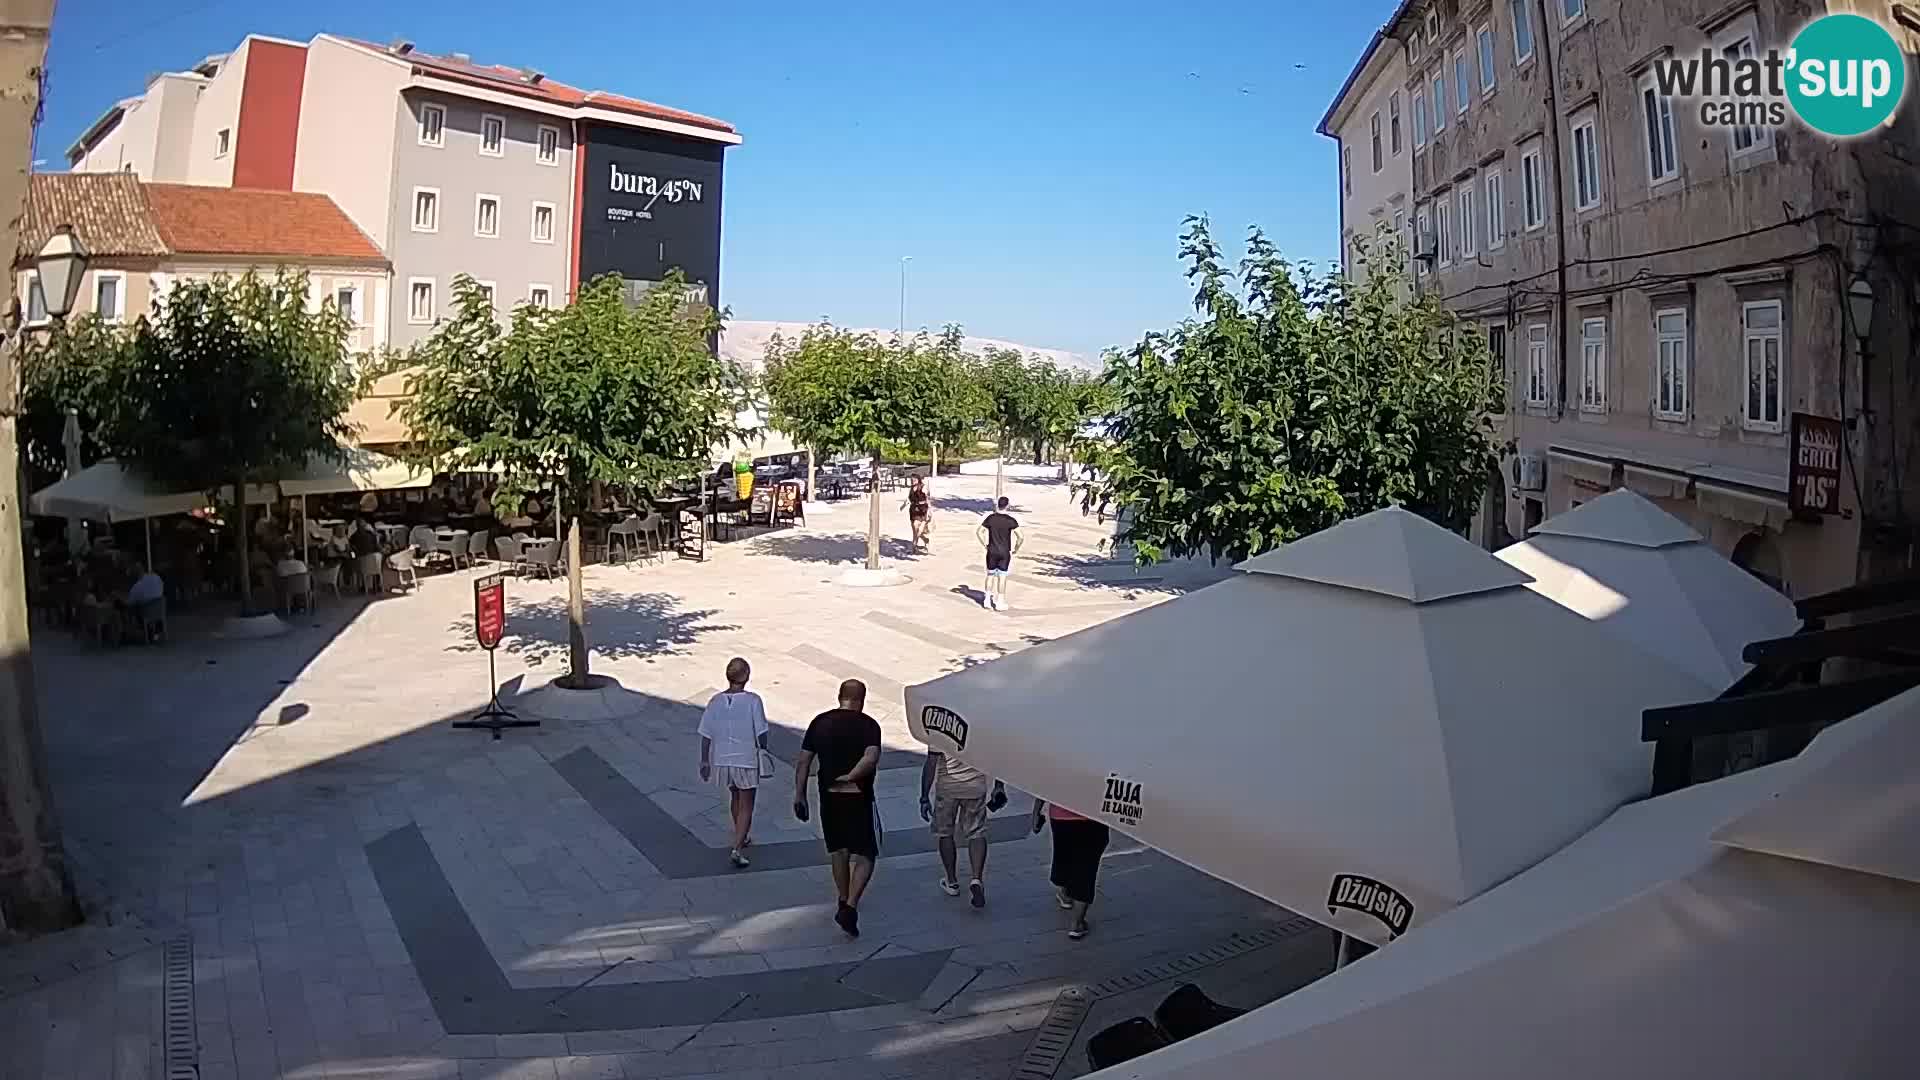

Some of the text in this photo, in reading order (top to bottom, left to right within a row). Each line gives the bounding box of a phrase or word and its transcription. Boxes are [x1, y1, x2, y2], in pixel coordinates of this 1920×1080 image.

[1798, 447, 1838, 470] GRILL
[1105, 772, 1142, 805] ŽUJA
[1101, 800, 1143, 819] JE ZAKON!
[1336, 878, 1406, 928] Ožujsko
